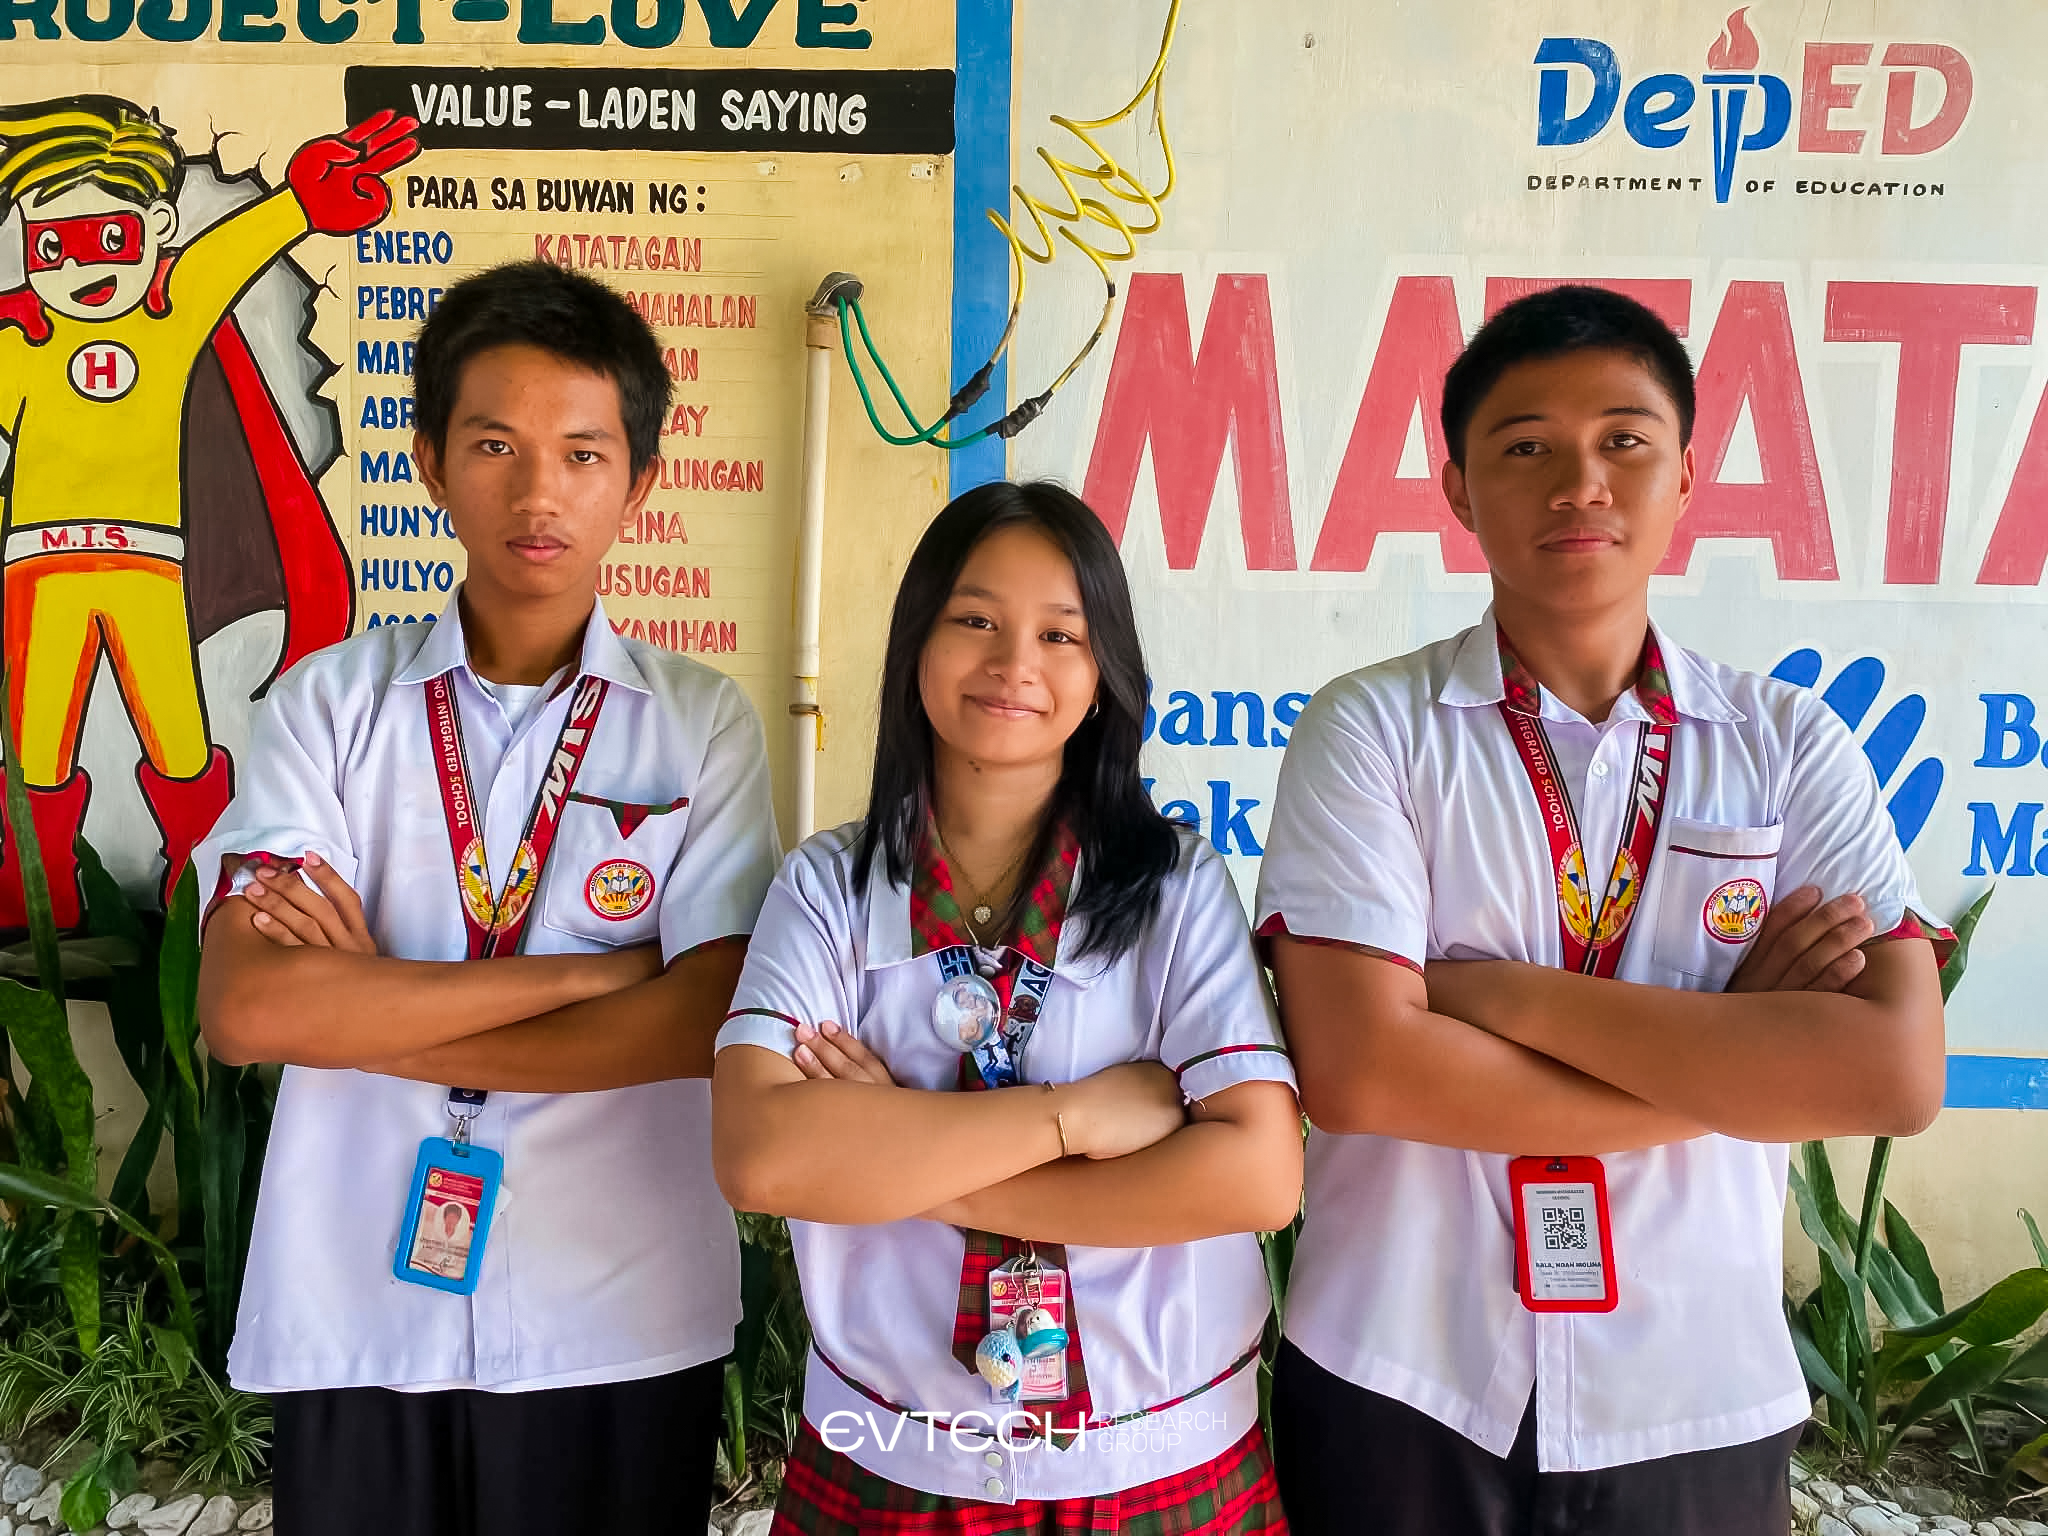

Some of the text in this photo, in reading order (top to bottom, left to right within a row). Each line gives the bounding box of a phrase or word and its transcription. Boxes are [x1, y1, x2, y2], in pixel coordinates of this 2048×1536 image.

[721, 89, 867, 135] SAYING
[1533, 37, 1974, 203] DepED
[406, 175, 478, 210] PARA
[491, 177, 526, 211] SA
[537, 179, 634, 214] BUWAN
[1527, 175, 1946, 197] DEPARTMENT OF EDUCATION
[356, 230, 453, 264] ENERO
[534, 233, 702, 272] KATATAGAN
[84, 352, 117, 390] H
[1082, 272, 2048, 586] MAAT
[360, 451, 417, 483] MA
[360, 558, 454, 592] HULYO
[541, 679, 603, 823] MIS
[1973, 692, 2048, 768] B
[435, 701, 459, 773] INTEGRATED
[449, 775, 470, 829] SCHOOL
[1540, 778, 1566, 833] SCHOOL
